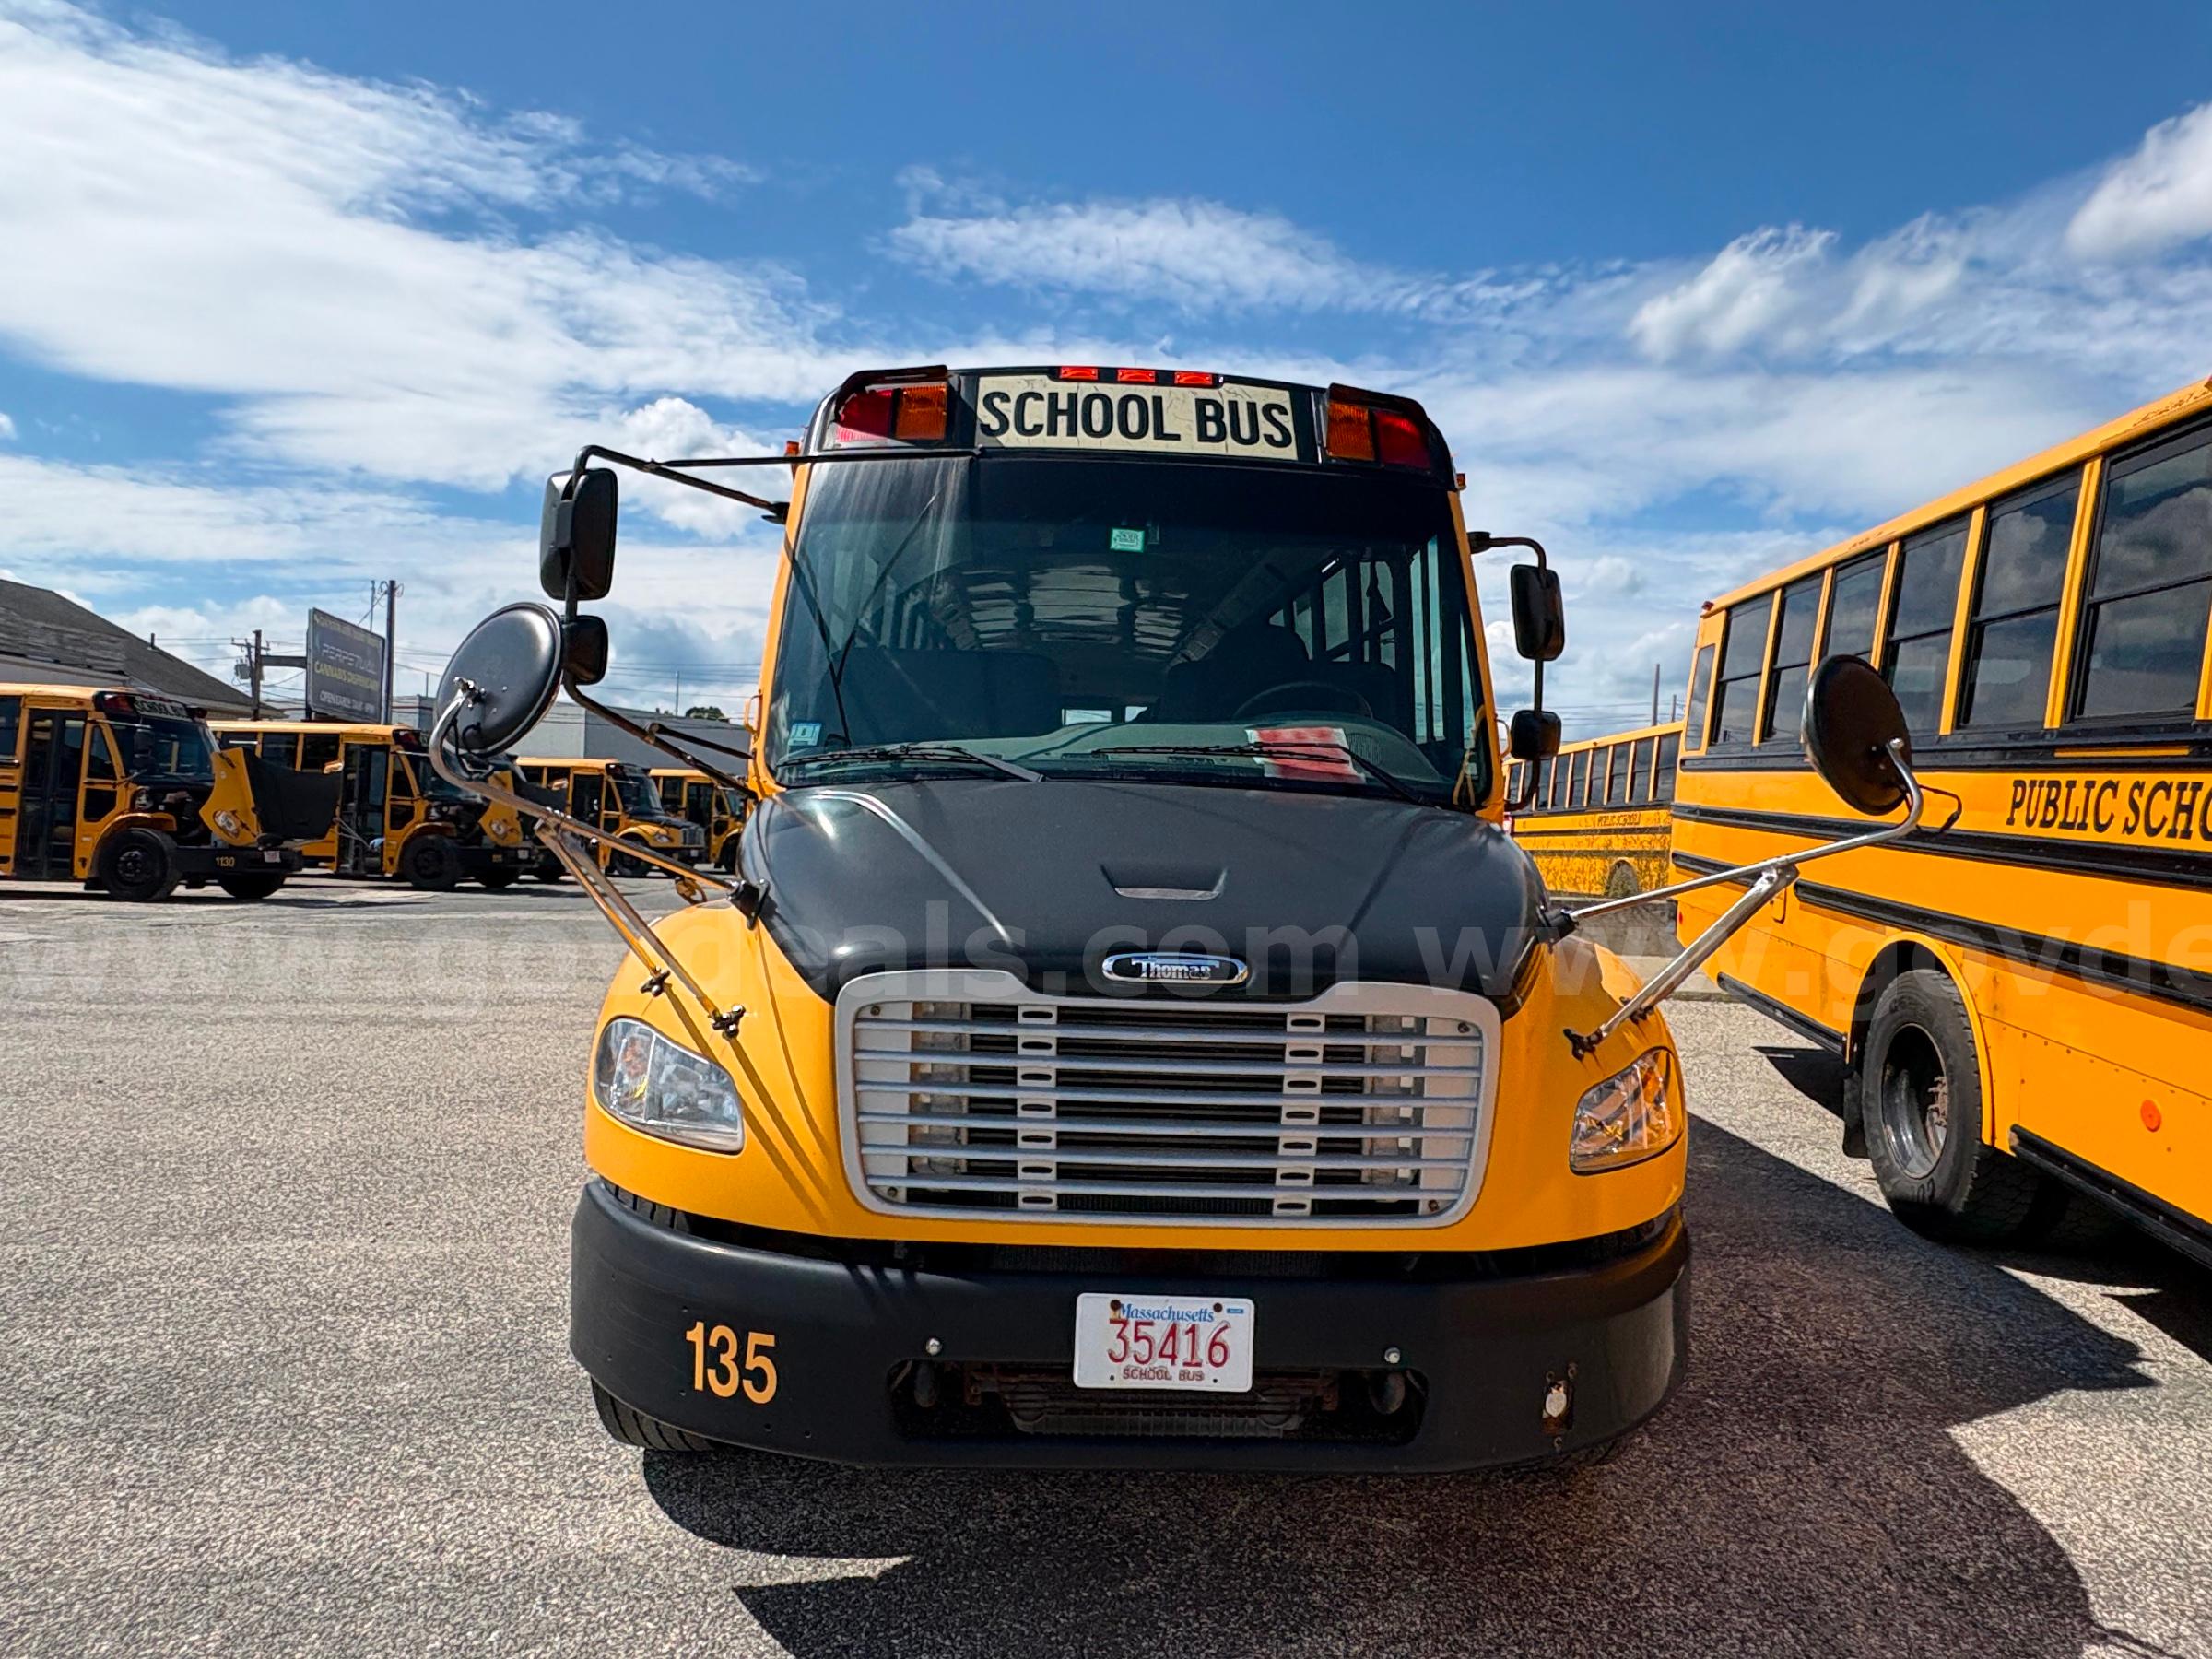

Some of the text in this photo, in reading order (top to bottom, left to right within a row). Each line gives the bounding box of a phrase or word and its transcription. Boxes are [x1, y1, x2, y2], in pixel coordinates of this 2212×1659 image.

[980, 391, 1293, 448] SCHOOL BUS
[2006, 779, 2120, 834] PUBLIC
[215, 855, 236, 867] 1130
[1131, 956, 1219, 980] Thomas
[1118, 1303, 1215, 1323] Massachusetts
[1107, 1318, 1231, 1369] 35416
[685, 1321, 778, 1405] 135
[1123, 1368, 1205, 1382] SCHOOL BUS
